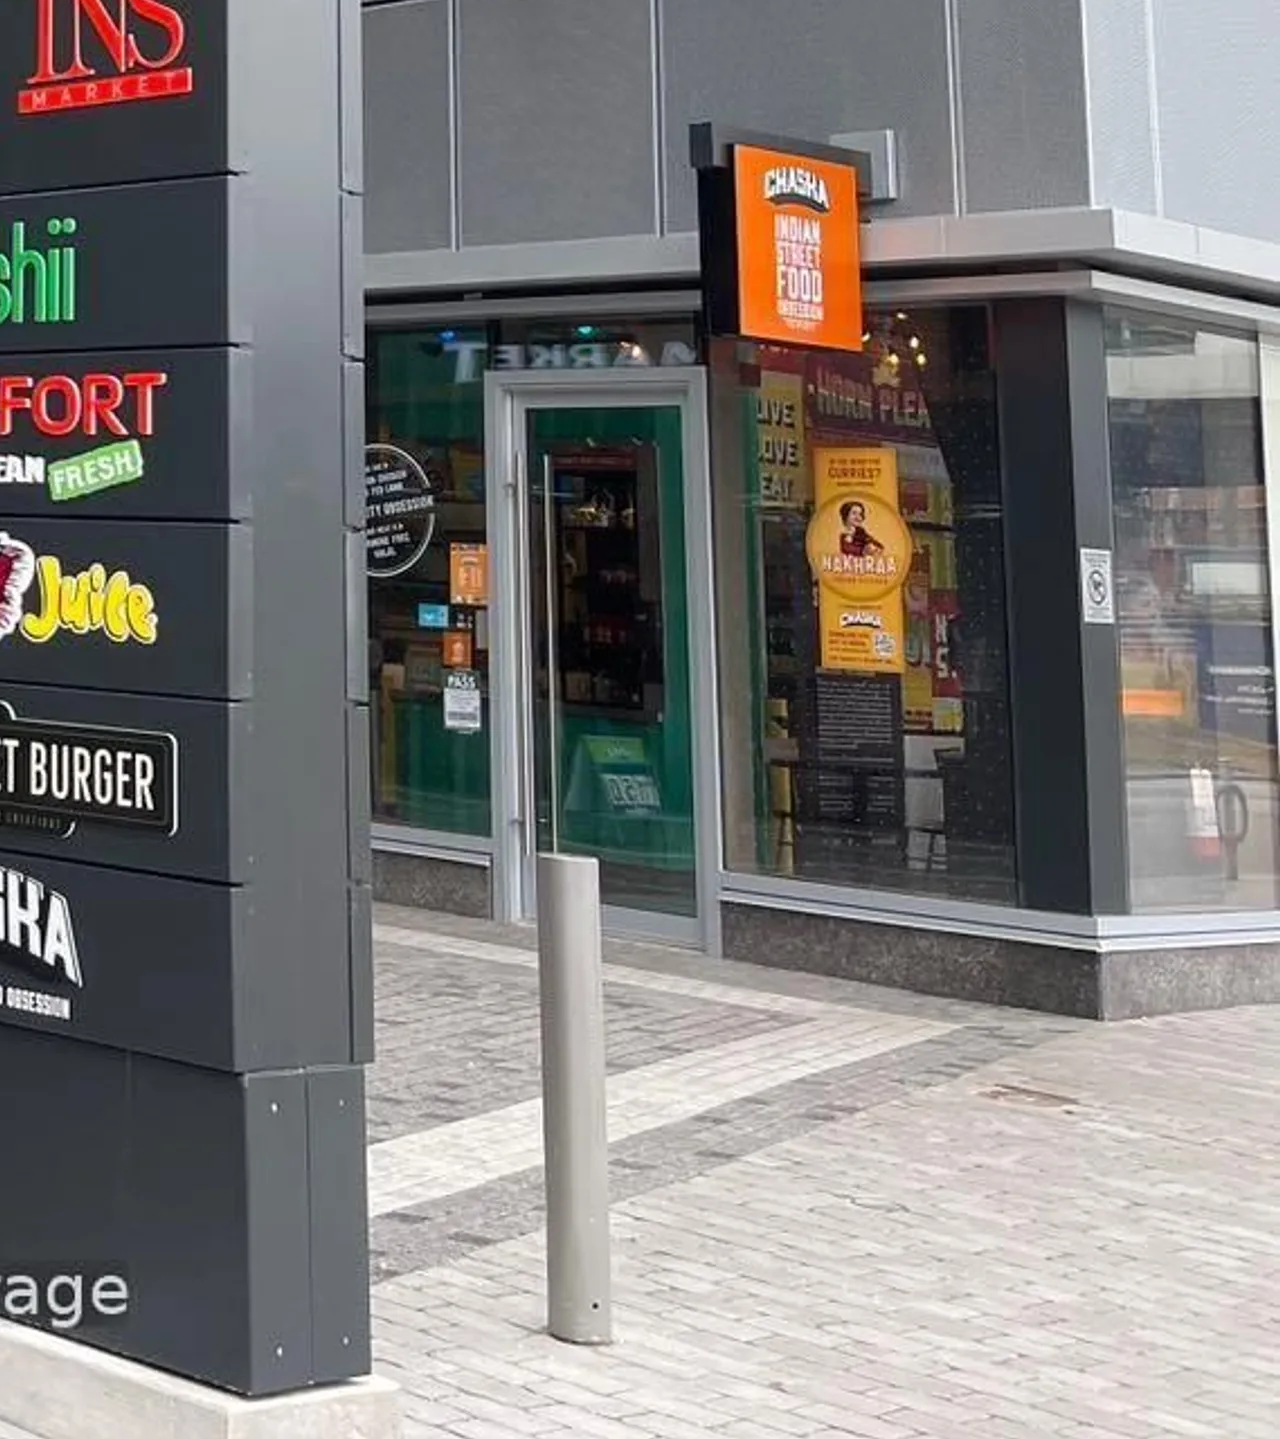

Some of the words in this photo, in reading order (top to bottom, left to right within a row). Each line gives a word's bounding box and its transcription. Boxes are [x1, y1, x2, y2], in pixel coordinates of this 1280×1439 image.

[31, 73, 177, 110] MARKET
[763, 166, 830, 210] CHASKA
[774, 213, 821, 245] INDIAN
[775, 242, 821, 269] STREET
[776, 266, 824, 304] FOOD
[880, 388, 932, 429] PLEA
[54, 449, 133, 493] FRESH
[20, 554, 159, 645] Juice
[448, 675, 476, 689] PASS
[29, 740, 155, 811] BURGER
